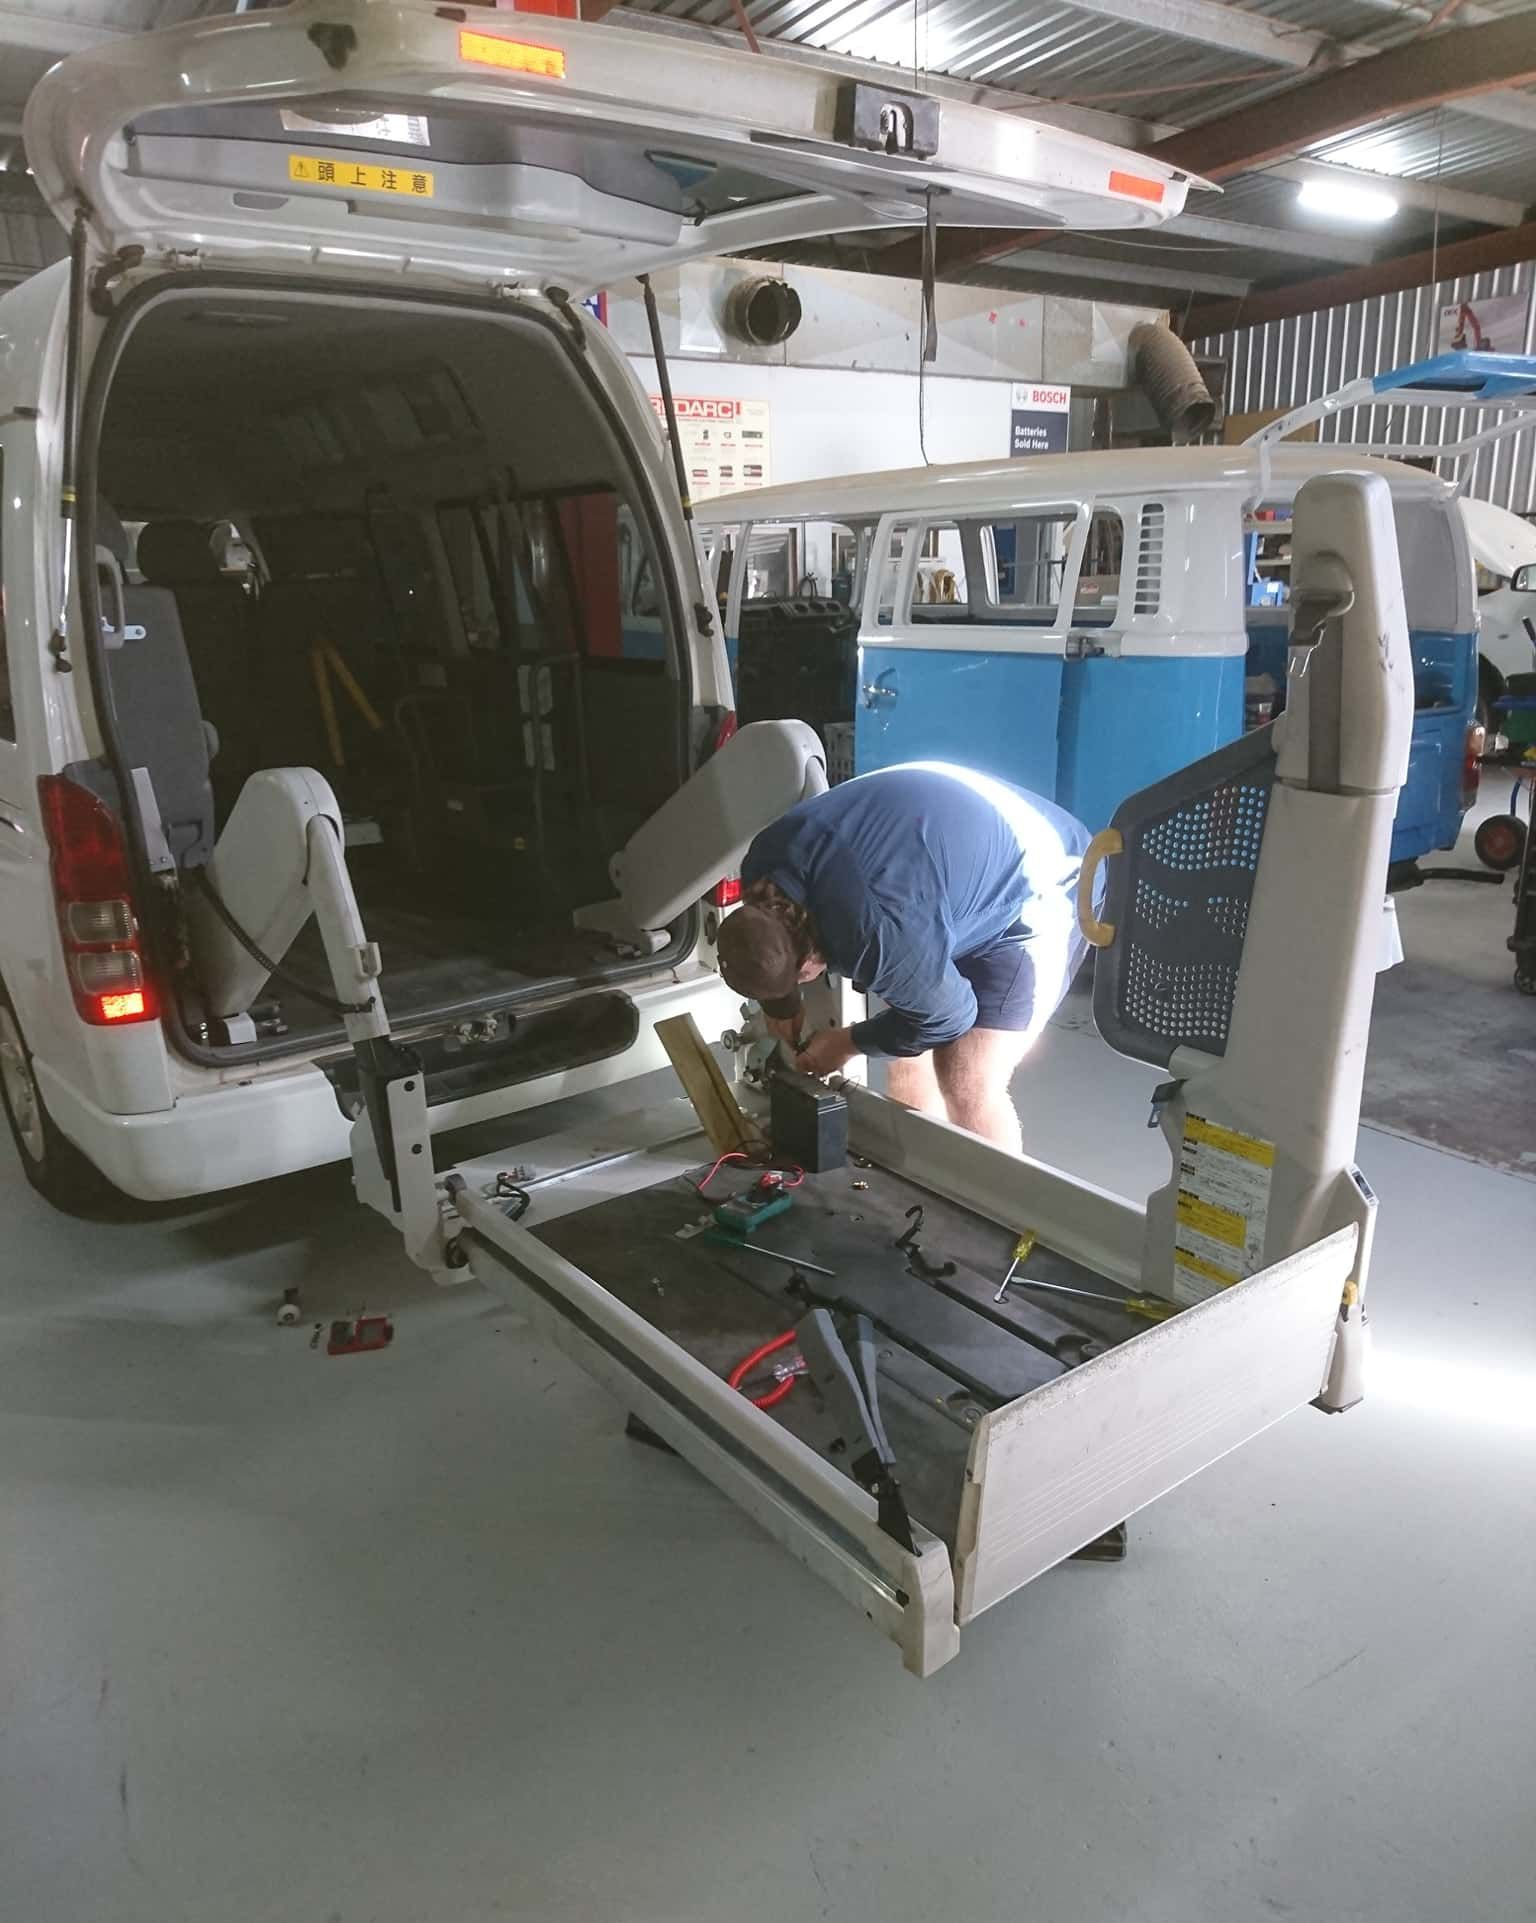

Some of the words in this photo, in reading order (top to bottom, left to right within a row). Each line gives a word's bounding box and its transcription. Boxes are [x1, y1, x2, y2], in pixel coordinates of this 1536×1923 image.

[318, 161, 427, 194] 頭上注意
[1032, 390, 1067, 405] BOSCH
[650, 399, 733, 418] RDARC
[1015, 425, 1047, 437] Batteries
[1014, 438, 1031, 449] Sold
[1032, 439, 1049, 450] Here
